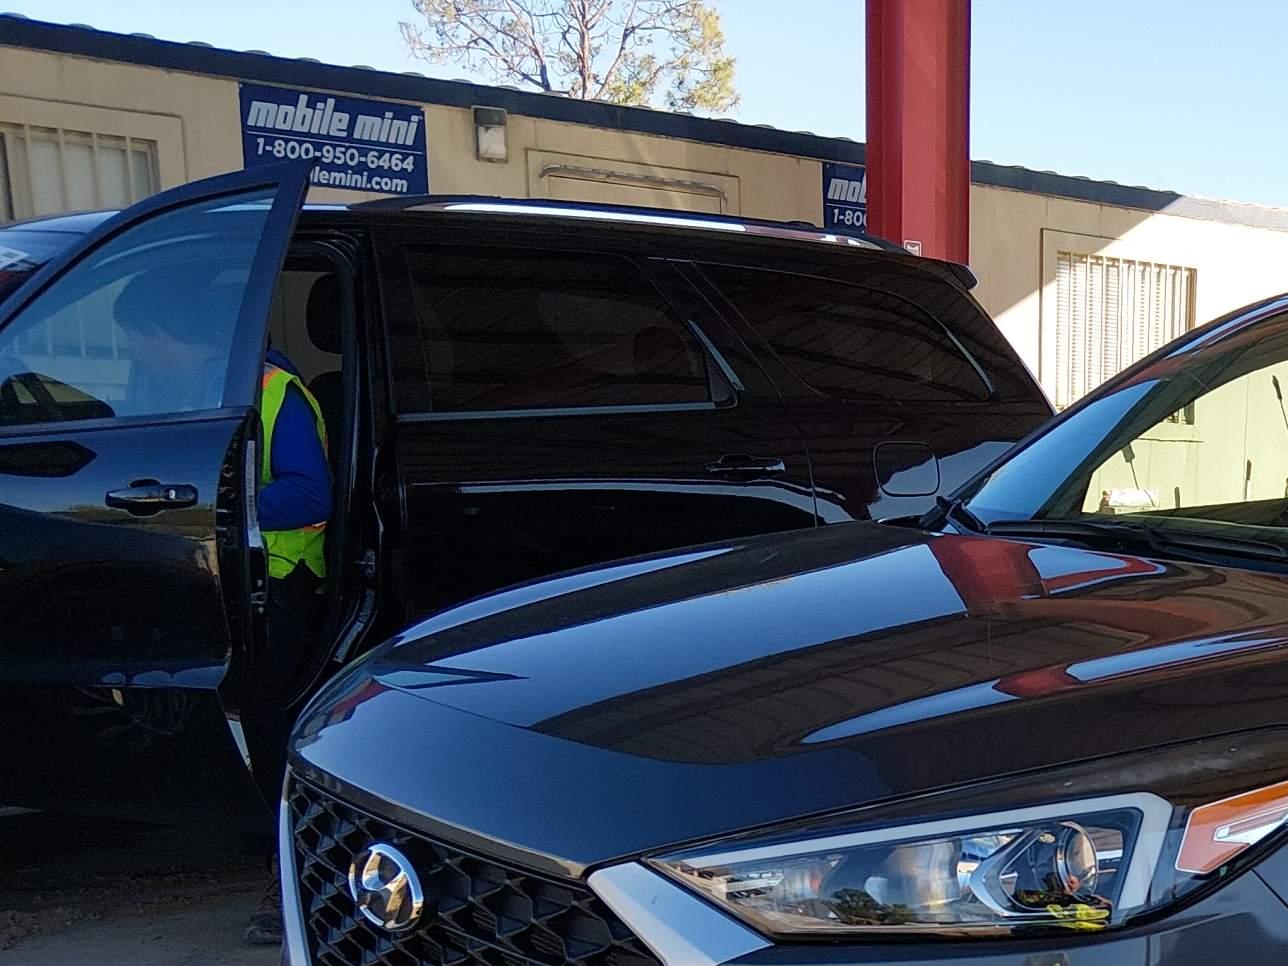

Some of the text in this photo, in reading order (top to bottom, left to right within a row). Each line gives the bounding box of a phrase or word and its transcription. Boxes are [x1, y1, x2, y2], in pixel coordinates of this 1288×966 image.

[247, 94, 420, 146] mobile mini
[256, 137, 415, 173] 1-800-950-6464
